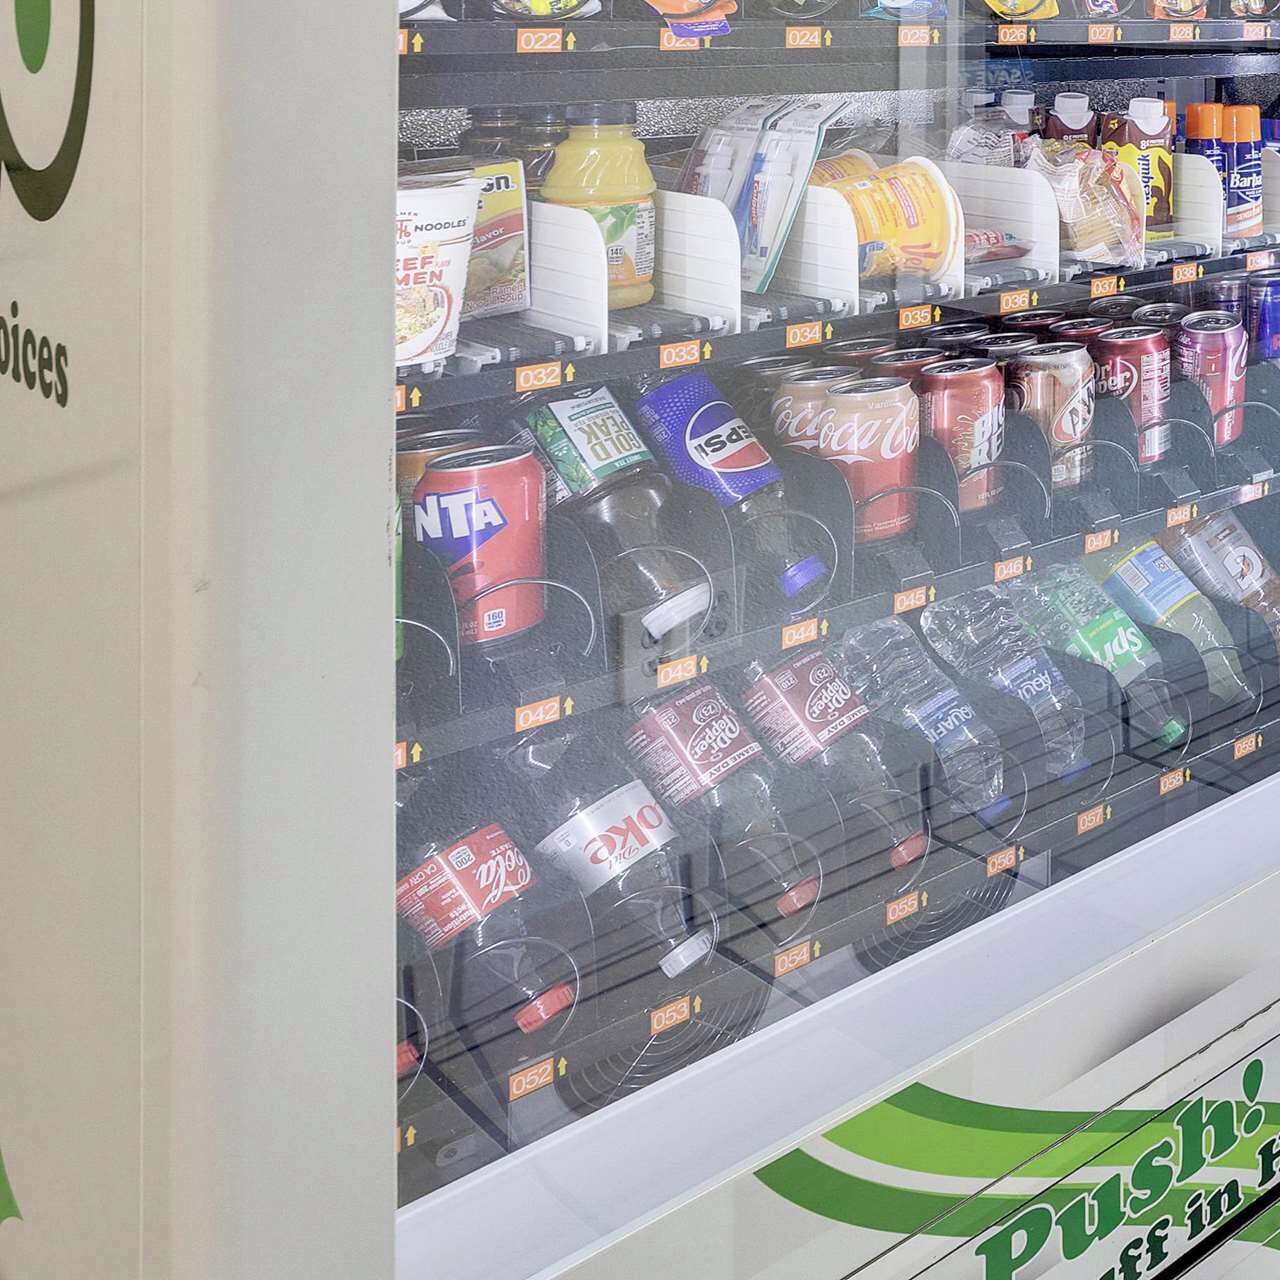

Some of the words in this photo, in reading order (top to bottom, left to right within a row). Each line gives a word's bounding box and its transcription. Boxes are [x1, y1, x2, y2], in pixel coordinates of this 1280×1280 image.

[521, 33, 560, 49] 022
[663, 30, 698, 47] 023
[788, 31, 820, 44] 024
[901, 30, 929, 42] 025
[1000, 30, 1025, 42] 026
[1091, 28, 1113, 40] 027
[1171, 27, 1192, 37] 028
[414, 219, 467, 232] NOODLES
[395, 256, 434, 271] EEF
[1175, 267, 1196, 278] 038
[395, 270, 444, 287] MEN
[1093, 278, 1115, 293] 037
[1003, 294, 1028, 309] 036
[902, 310, 930, 325] 035
[790, 325, 820, 342] 034
[0, 301, 69, 408] oices
[661, 344, 700, 365] 033
[519, 367, 559, 386] 032
[578, 414, 631, 445] PEAK
[590, 432, 641, 462] GOLD
[694, 424, 753, 461] EPSI
[972, 431, 1004, 467] RE
[414, 491, 504, 542] NTA
[1168, 511, 1189, 524] 048
[1087, 535, 1111, 550] 047
[996, 560, 1024, 578] 046
[896, 595, 925, 610] 045
[486, 611, 503, 621] 160
[784, 623, 818, 644] 044
[1098, 625, 1142, 671] Spr
[660, 663, 695, 682] 043
[1018, 670, 1052, 699] AQU
[518, 702, 559, 729] 042
[925, 704, 976, 744] QUAFI
[825, 717, 846, 735] DAY
[690, 713, 739, 759] Pepper
[1234, 739, 1256, 756] 059
[707, 758, 730, 778] DAY
[1160, 774, 1184, 791] 058
[1078, 813, 1105, 832] 057
[583, 803, 663, 867] oke
[425, 862, 438, 875] CA
[456, 854, 473, 869] 200
[988, 852, 1015, 873] 056
[475, 848, 530, 910] Cola
[888, 898, 919, 920] 055
[777, 945, 810, 972] 054
[653, 999, 690, 1028] 053
[511, 1062, 554, 1095] 052
[975, 1058, 1267, 1280] Push!
[1188, 1179, 1242, 1238] in
